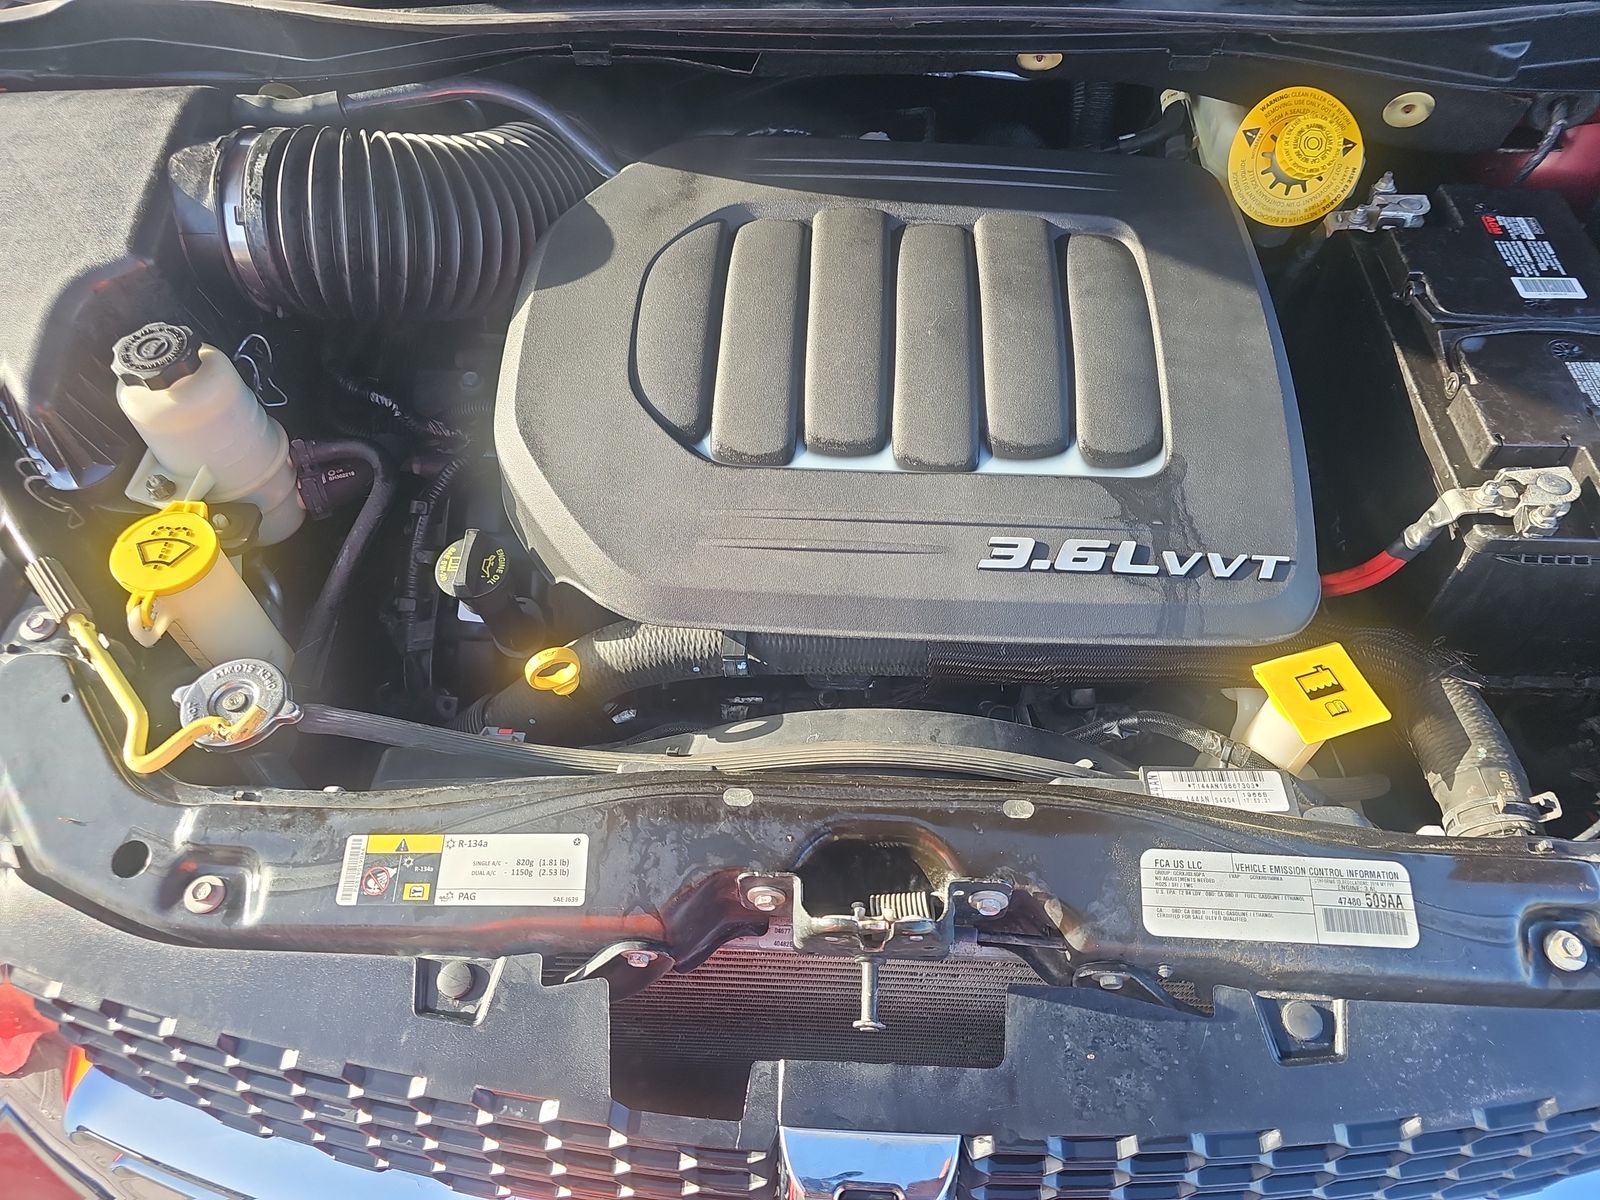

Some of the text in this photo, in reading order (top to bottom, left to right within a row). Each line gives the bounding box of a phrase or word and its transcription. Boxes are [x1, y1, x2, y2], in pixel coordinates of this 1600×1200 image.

[1260, 94, 1291, 112] WARNING:
[1310, 93, 1327, 102] FILLER
[1306, 100, 1321, 109] ONLY
[1321, 105, 1333, 114] DOT
[1268, 112, 1284, 127] FROM
[1347, 167, 1358, 184] MISE
[1340, 184, 1349, 194] EN
[444, 547, 457, 560] SAE
[486, 548, 506, 586] ENGINE OIL
[213, 664, 278, 691] OPEN SLOWLY
[1499, 771, 1514, 790] RAD
[458, 839, 488, 848] R-134a
[491, 860, 501, 868] A/C
[516, 858, 534, 868] 820g
[538, 858, 557, 868] (1.81
[558, 858, 570, 868] lb)
[1154, 858, 1203, 870] FCA US LLC
[511, 868, 533, 878] 1150g
[538, 868, 557, 878] (2.53
[558, 868, 570, 878] lb)
[1235, 863, 1399, 880] VEHICLE EMISSION CONTROL INFORMATION
[458, 892, 477, 901] PAG
[1337, 893, 1404, 909] 47480 509AA
